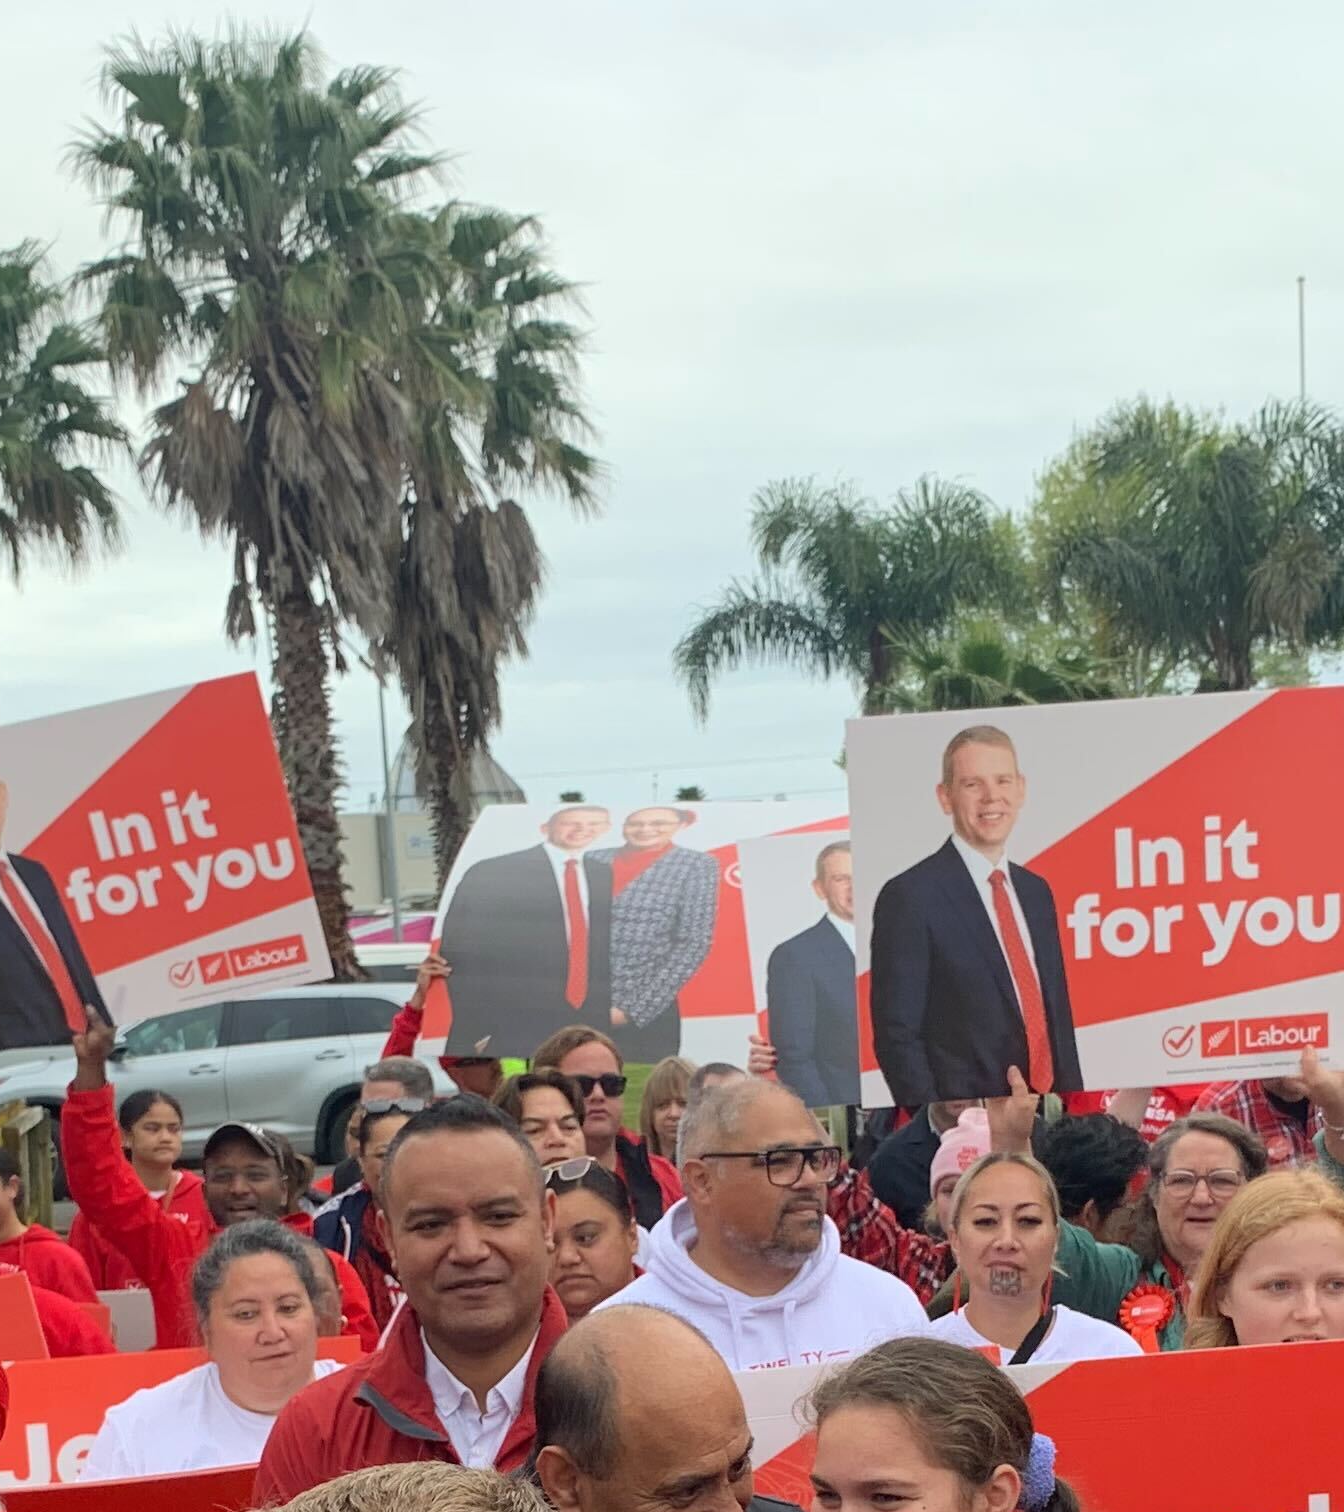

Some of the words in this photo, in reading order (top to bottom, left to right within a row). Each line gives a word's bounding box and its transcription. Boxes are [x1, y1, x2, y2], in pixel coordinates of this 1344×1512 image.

[88, 810, 157, 861] In
[161, 789, 217, 845] it
[1115, 827, 1184, 888] In
[1204, 816, 1259, 882] it
[66, 867, 162, 922] for
[172, 838, 295, 912] you
[235, 945, 299, 971] Labour
[1067, 893, 1184, 960] for
[1197, 893, 1340, 966] you
[1245, 1025, 1321, 1048] Labour
